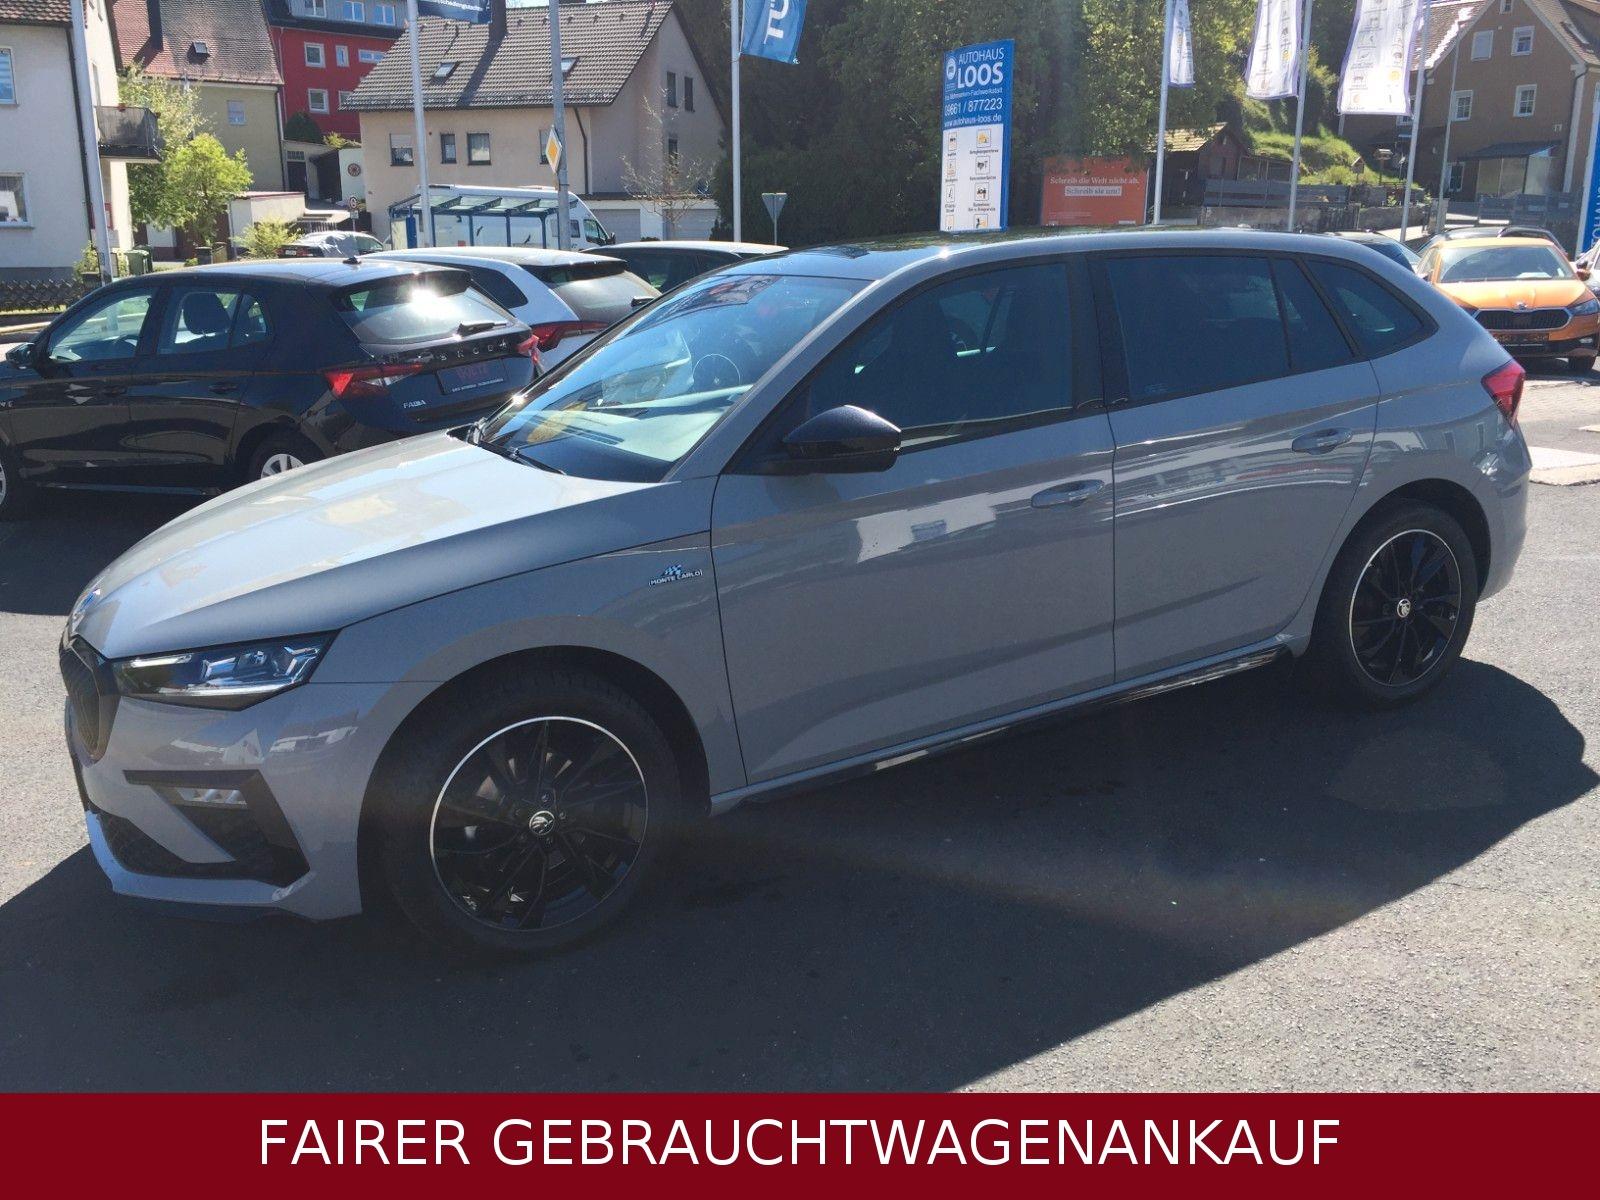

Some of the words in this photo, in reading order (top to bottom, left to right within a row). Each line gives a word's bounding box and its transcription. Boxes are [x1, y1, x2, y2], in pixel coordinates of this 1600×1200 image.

[959, 47, 1005, 65] AUTOHAUS
[957, 62, 1004, 88] LOOS
[968, 97, 1003, 112] 877223
[403, 399, 427, 409] FABIA
[650, 576, 676, 585] MONTE
[676, 570, 701, 580] CARLO
